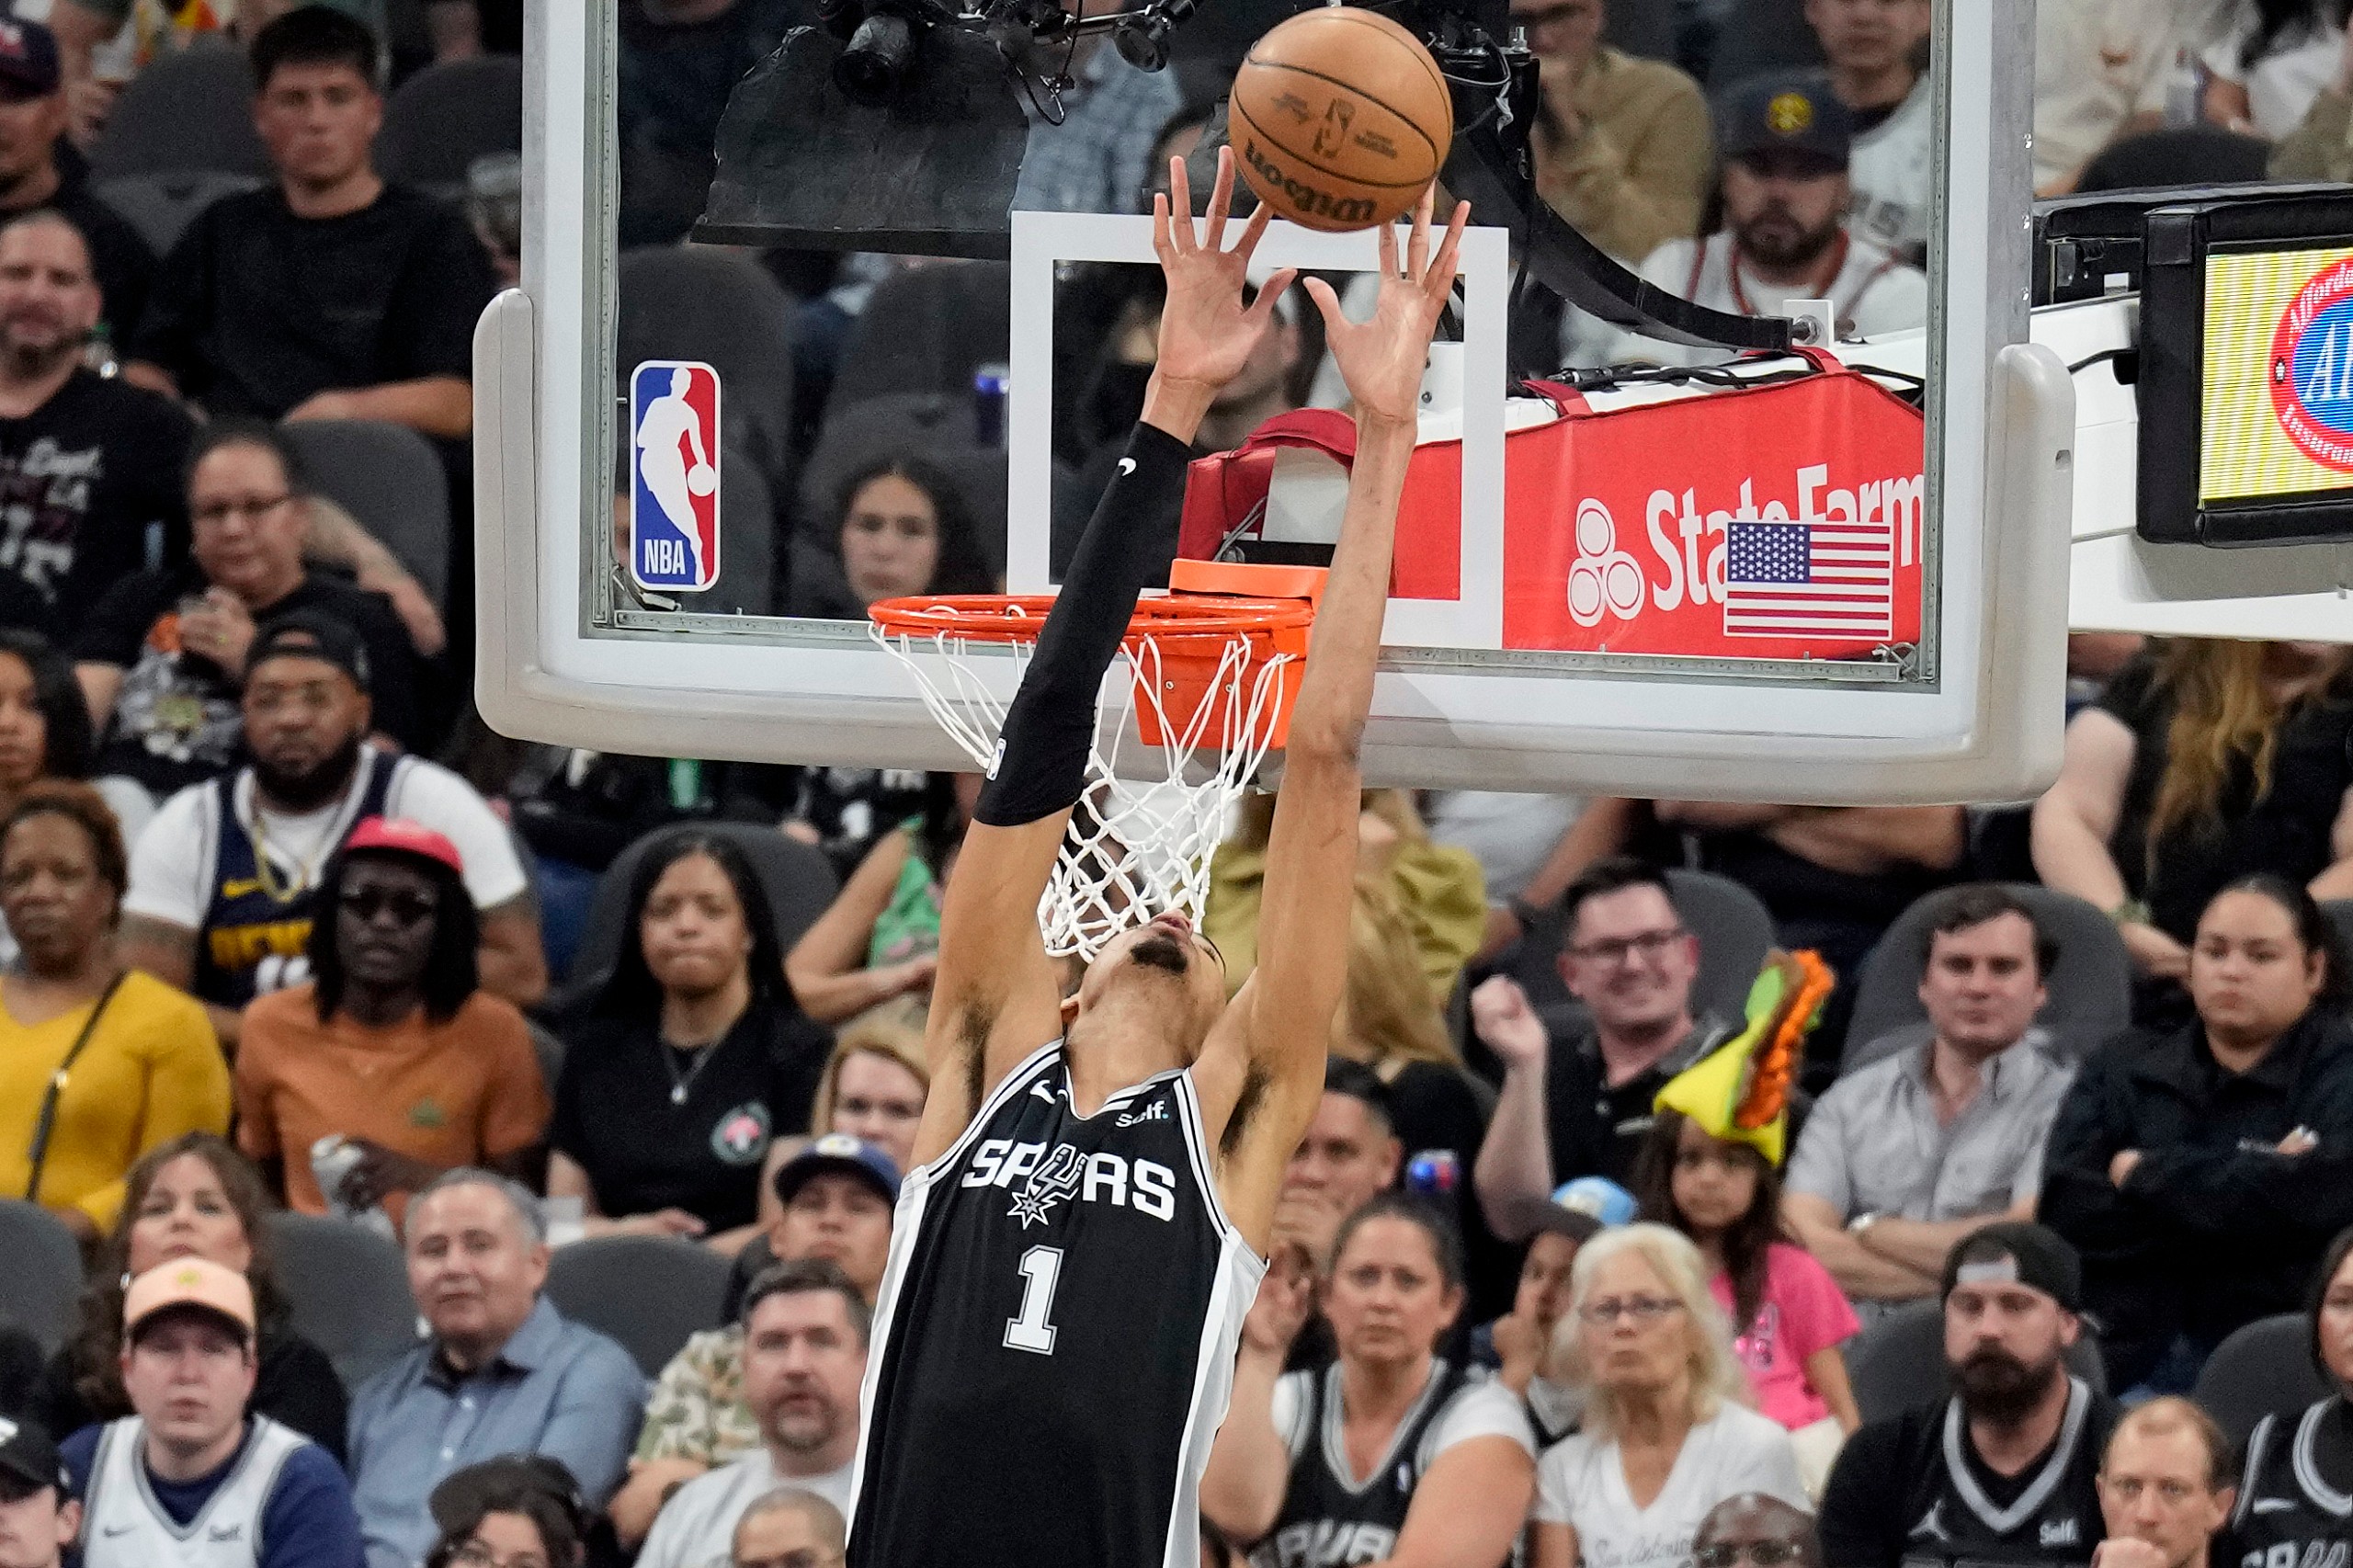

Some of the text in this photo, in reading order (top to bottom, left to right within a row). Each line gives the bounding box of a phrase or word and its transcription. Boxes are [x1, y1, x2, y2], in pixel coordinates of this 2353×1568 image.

[644, 539, 686, 574] NBA
[1646, 477, 1790, 611] Sta
[1002, 1244, 1064, 1356] 1
